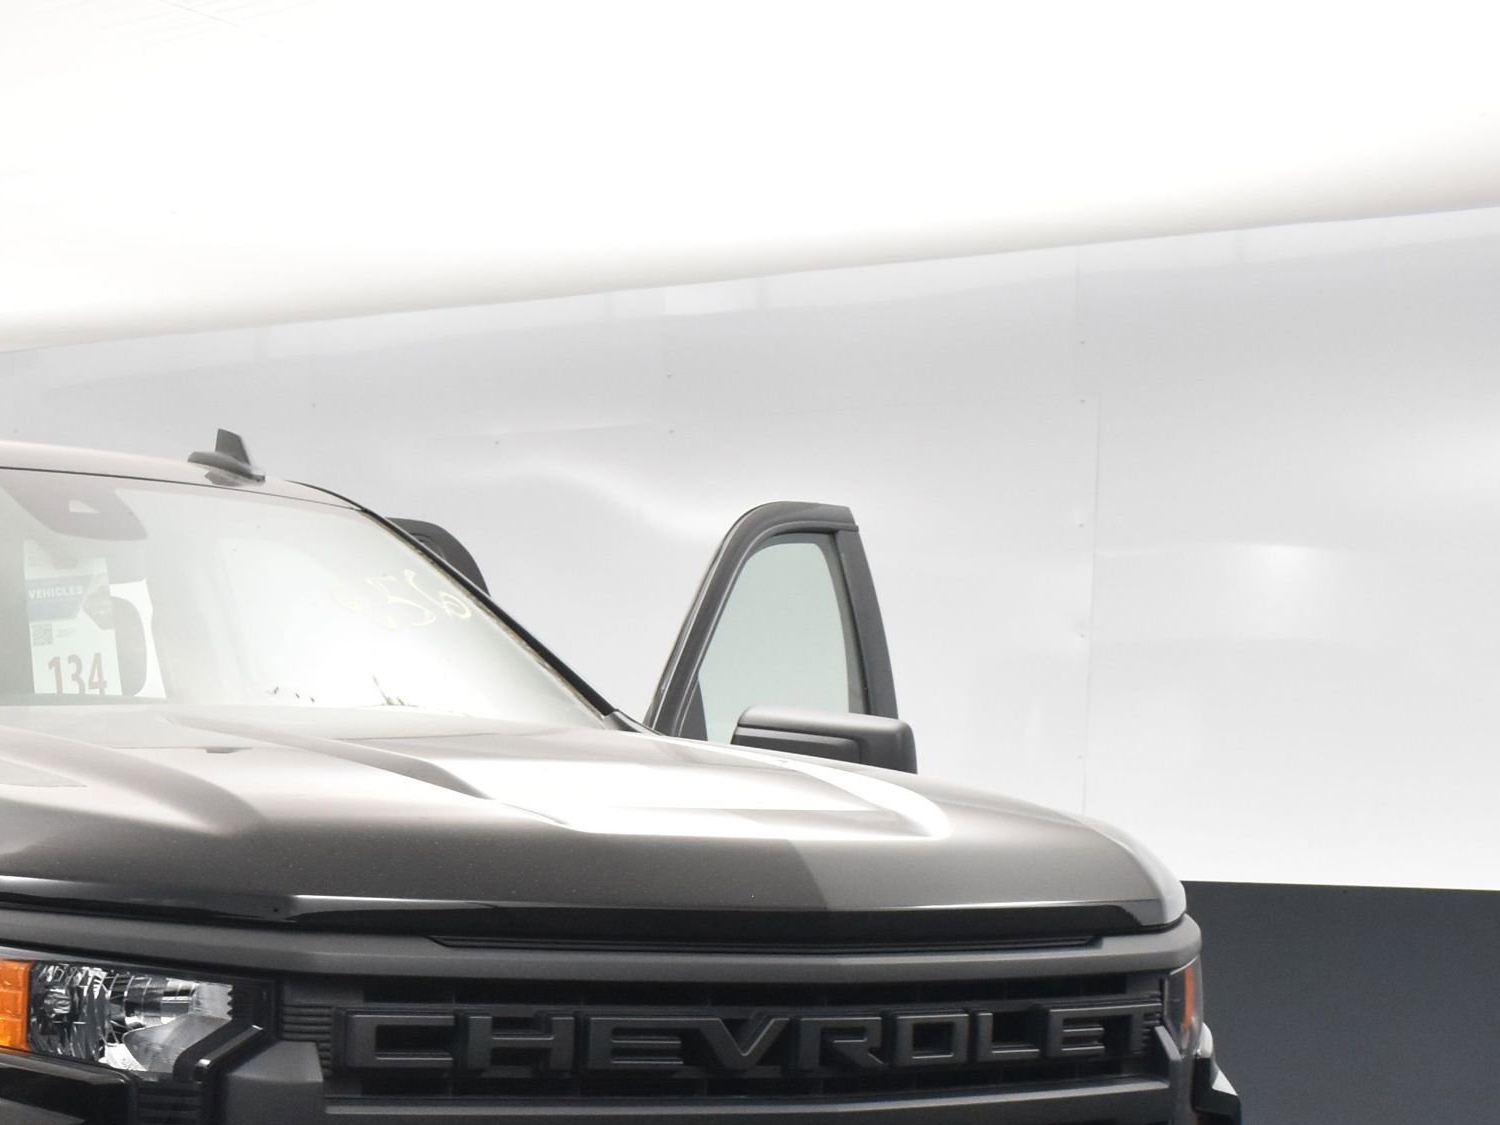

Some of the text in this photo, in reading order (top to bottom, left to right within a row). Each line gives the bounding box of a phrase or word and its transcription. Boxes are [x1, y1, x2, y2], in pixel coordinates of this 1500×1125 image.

[27, 585, 84, 600] VEHICLES
[47, 652, 108, 696] 134
[344, 1000, 1163, 1070] CHEVROLET
